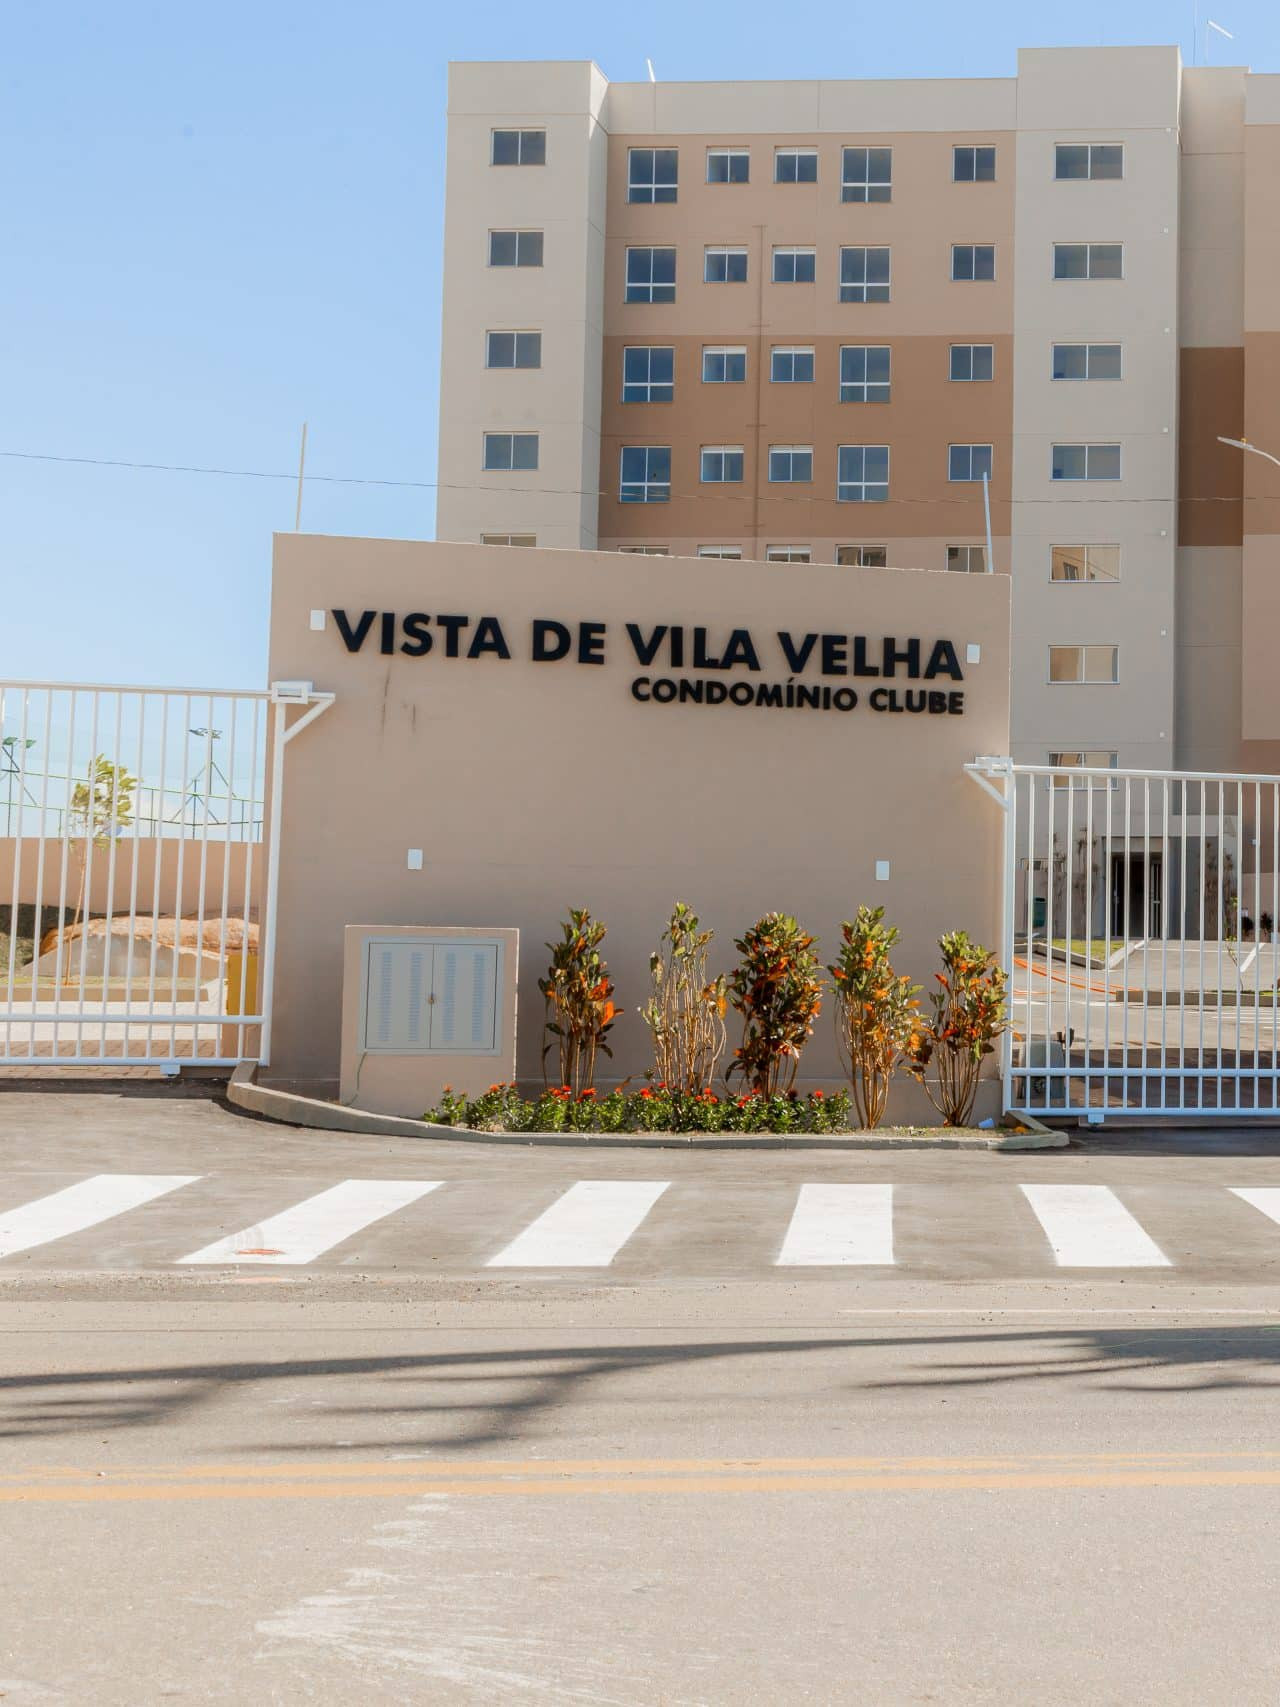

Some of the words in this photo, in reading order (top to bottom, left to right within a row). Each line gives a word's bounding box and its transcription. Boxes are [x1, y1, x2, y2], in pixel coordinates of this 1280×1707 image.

[331, 609, 512, 660] VISTA
[531, 619, 607, 666] DE
[624, 623, 762, 672] VILA
[776, 631, 964, 682] VELHA
[630, 676, 859, 713] CONDOMÍNIO
[868, 687, 965, 716] CLUBE
